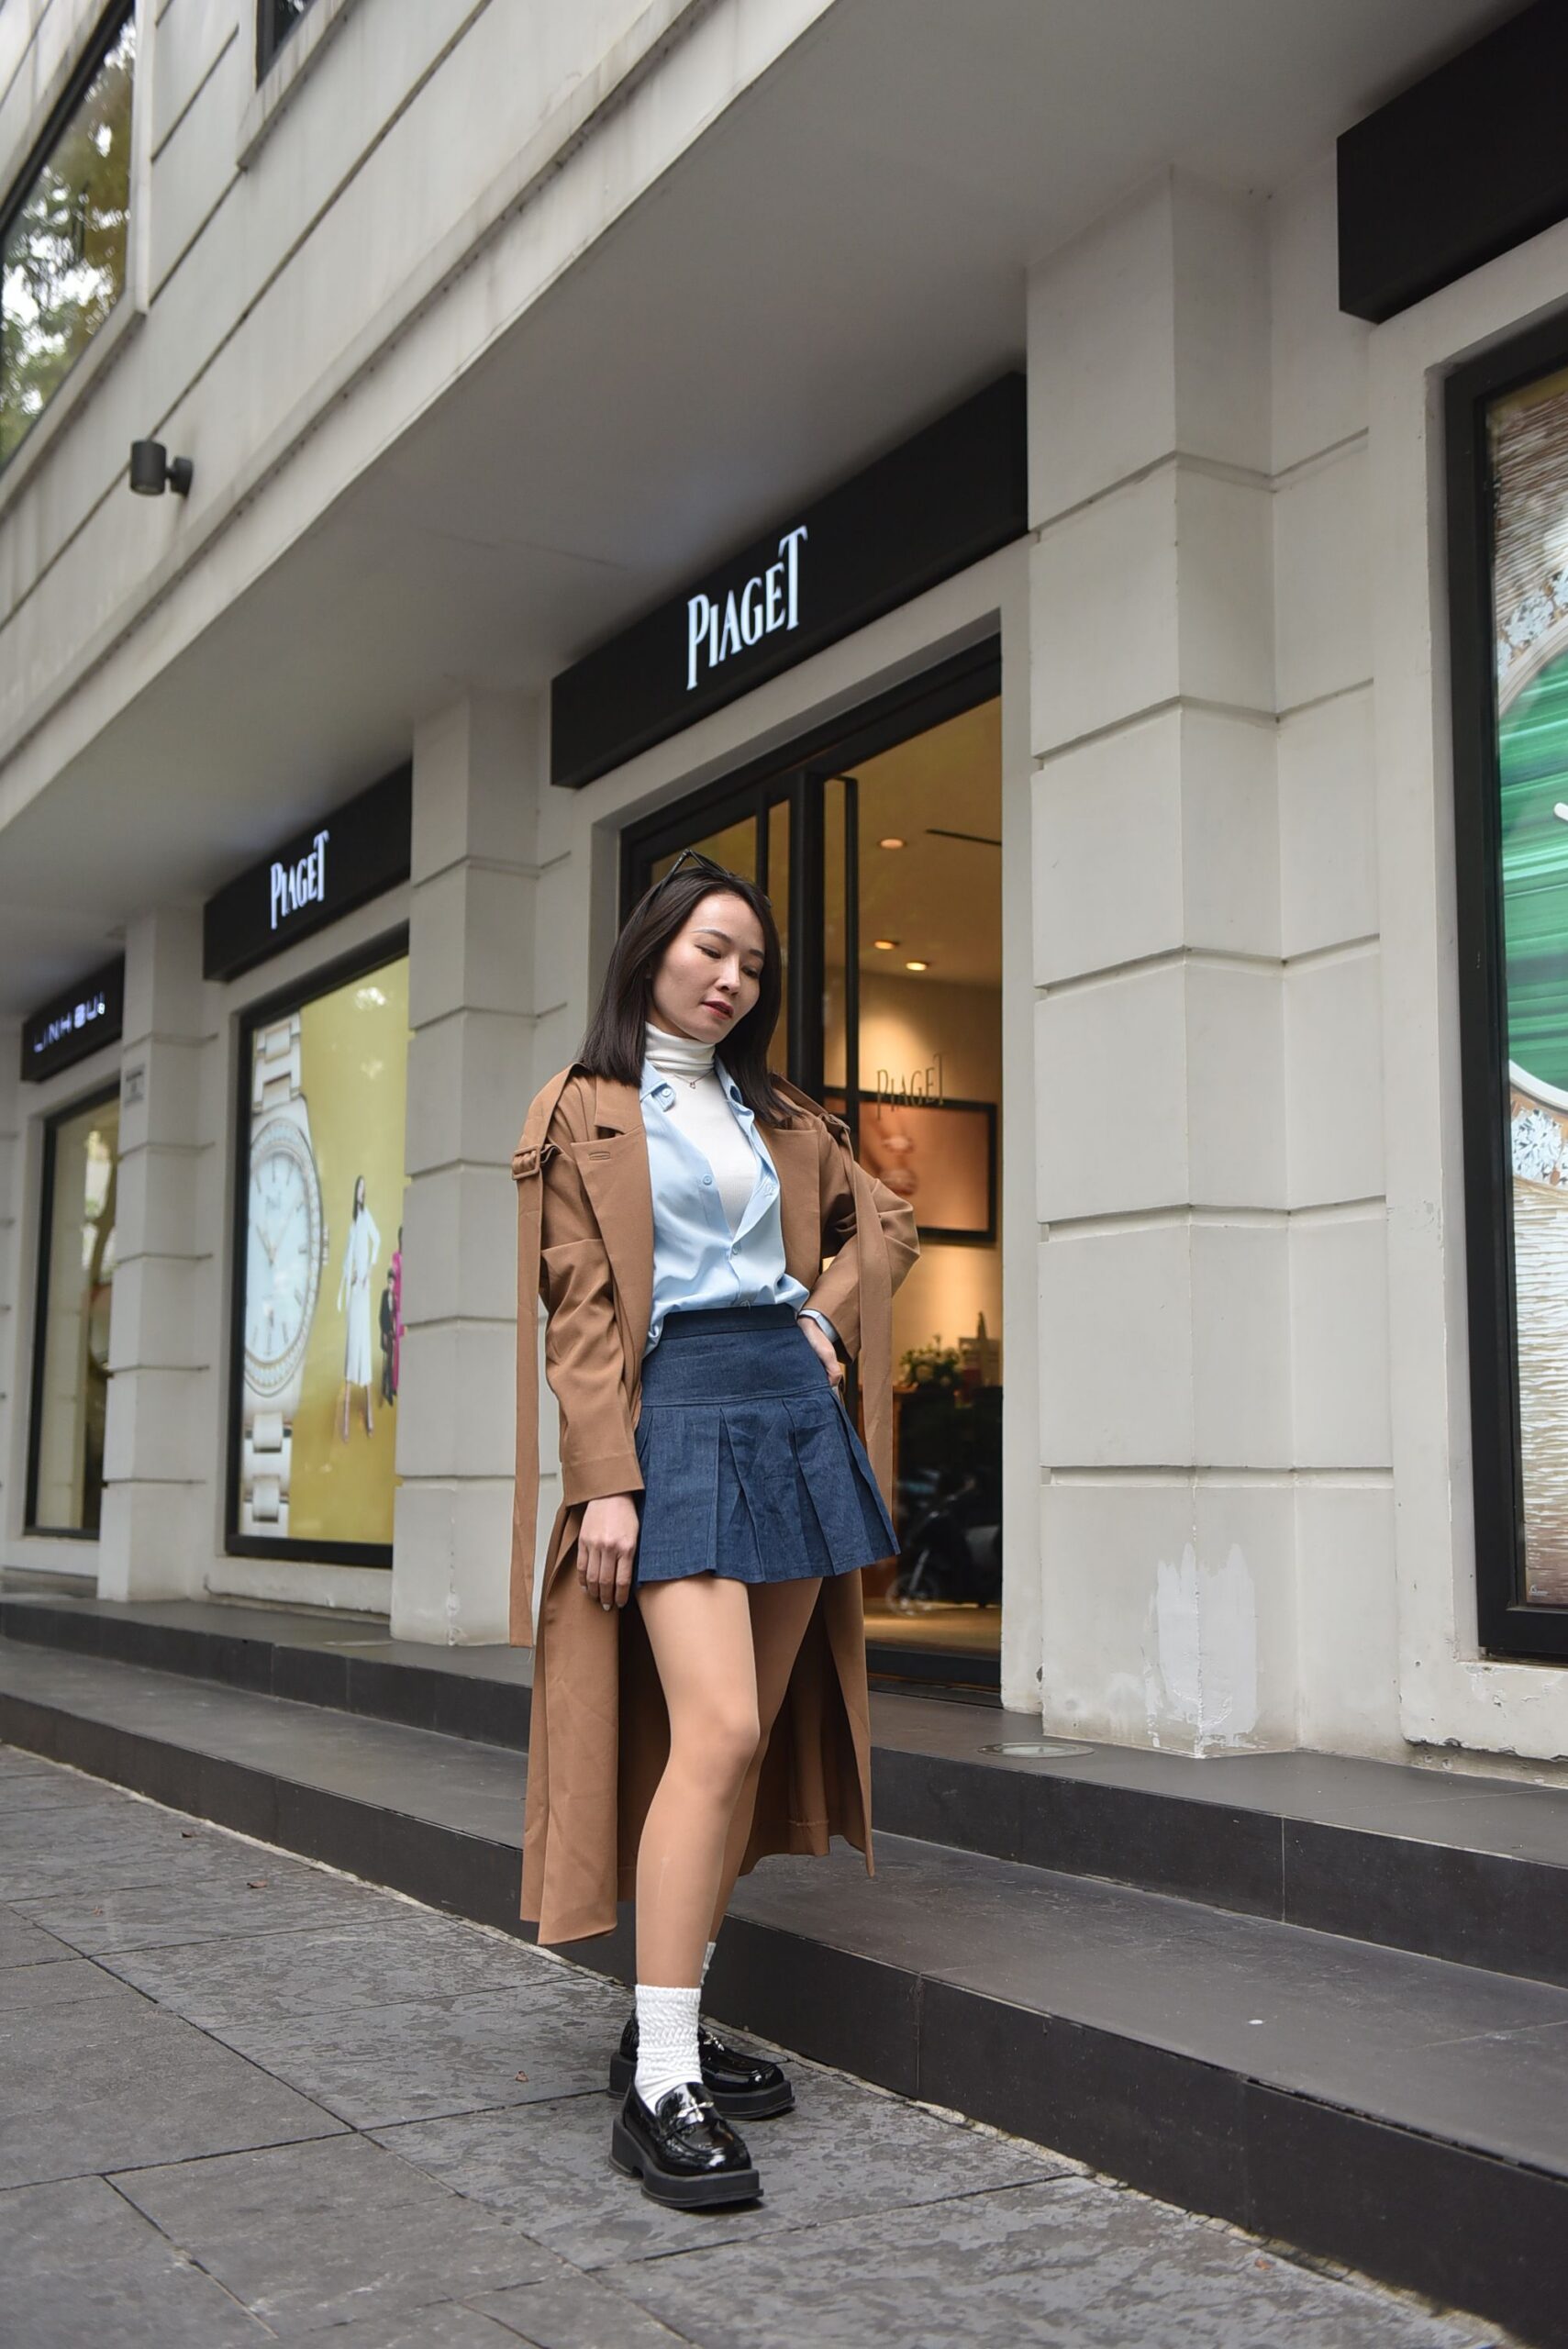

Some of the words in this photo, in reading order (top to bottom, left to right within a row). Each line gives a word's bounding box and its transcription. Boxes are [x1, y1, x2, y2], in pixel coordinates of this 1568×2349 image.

[686, 525, 808, 690] PIAGET
[271, 829, 330, 930] PIAGET
[876, 1051, 947, 1121] PIAGET
